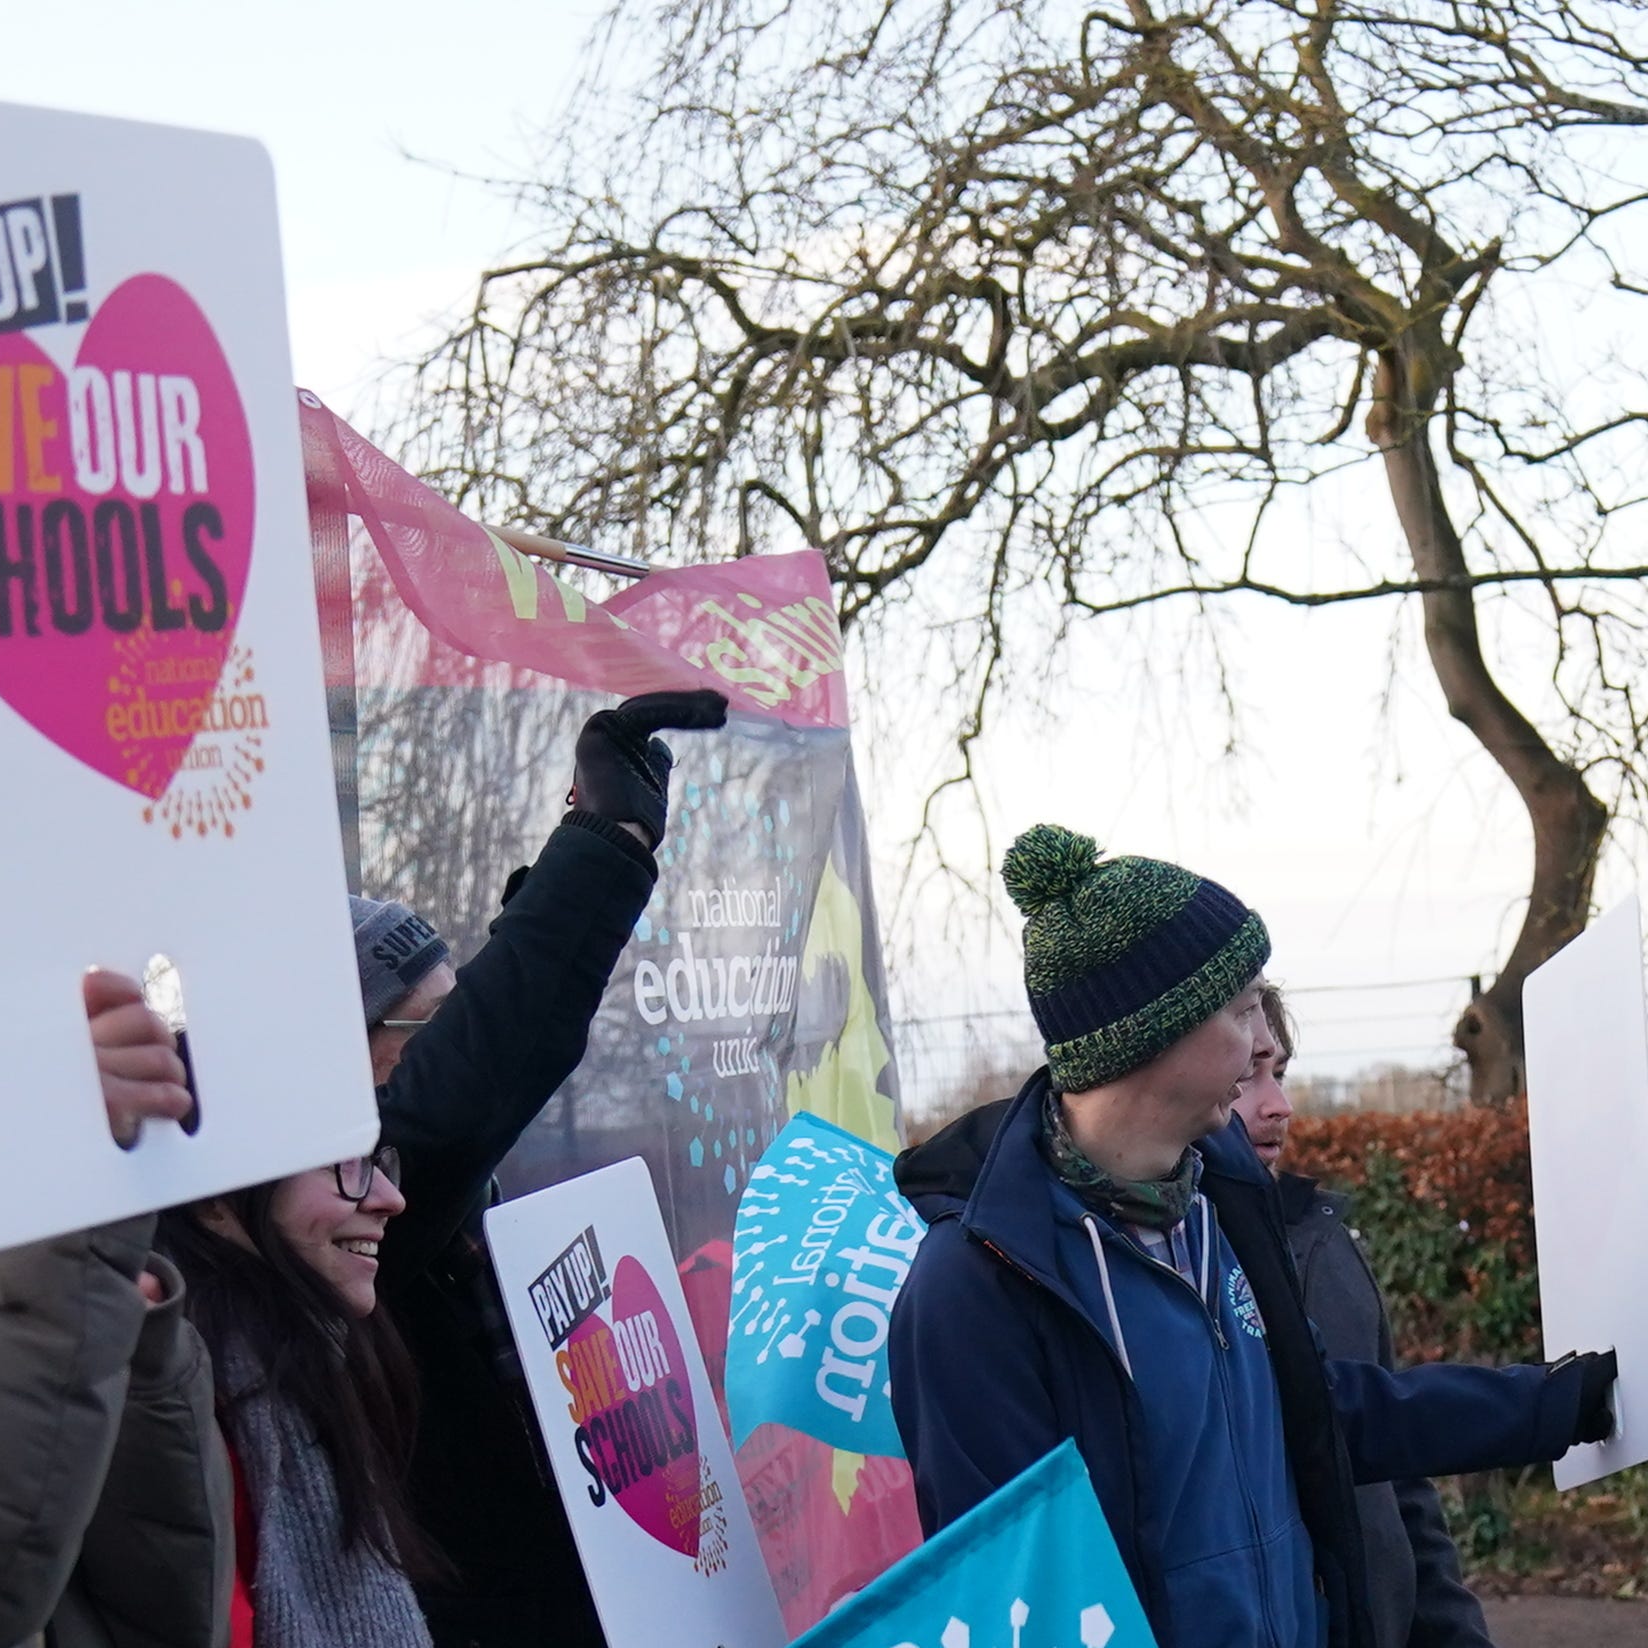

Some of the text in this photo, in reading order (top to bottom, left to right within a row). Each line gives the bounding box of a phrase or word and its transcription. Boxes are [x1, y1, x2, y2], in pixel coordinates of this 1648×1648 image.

[66, 366, 209, 498] OUR
[106, 686, 269, 741] education
[689, 876, 780, 927] national
[531, 1224, 612, 1342] PAY UP!
[556, 1310, 671, 1424] SAVE OUR
[574, 1378, 694, 1508] SCHOOLS
